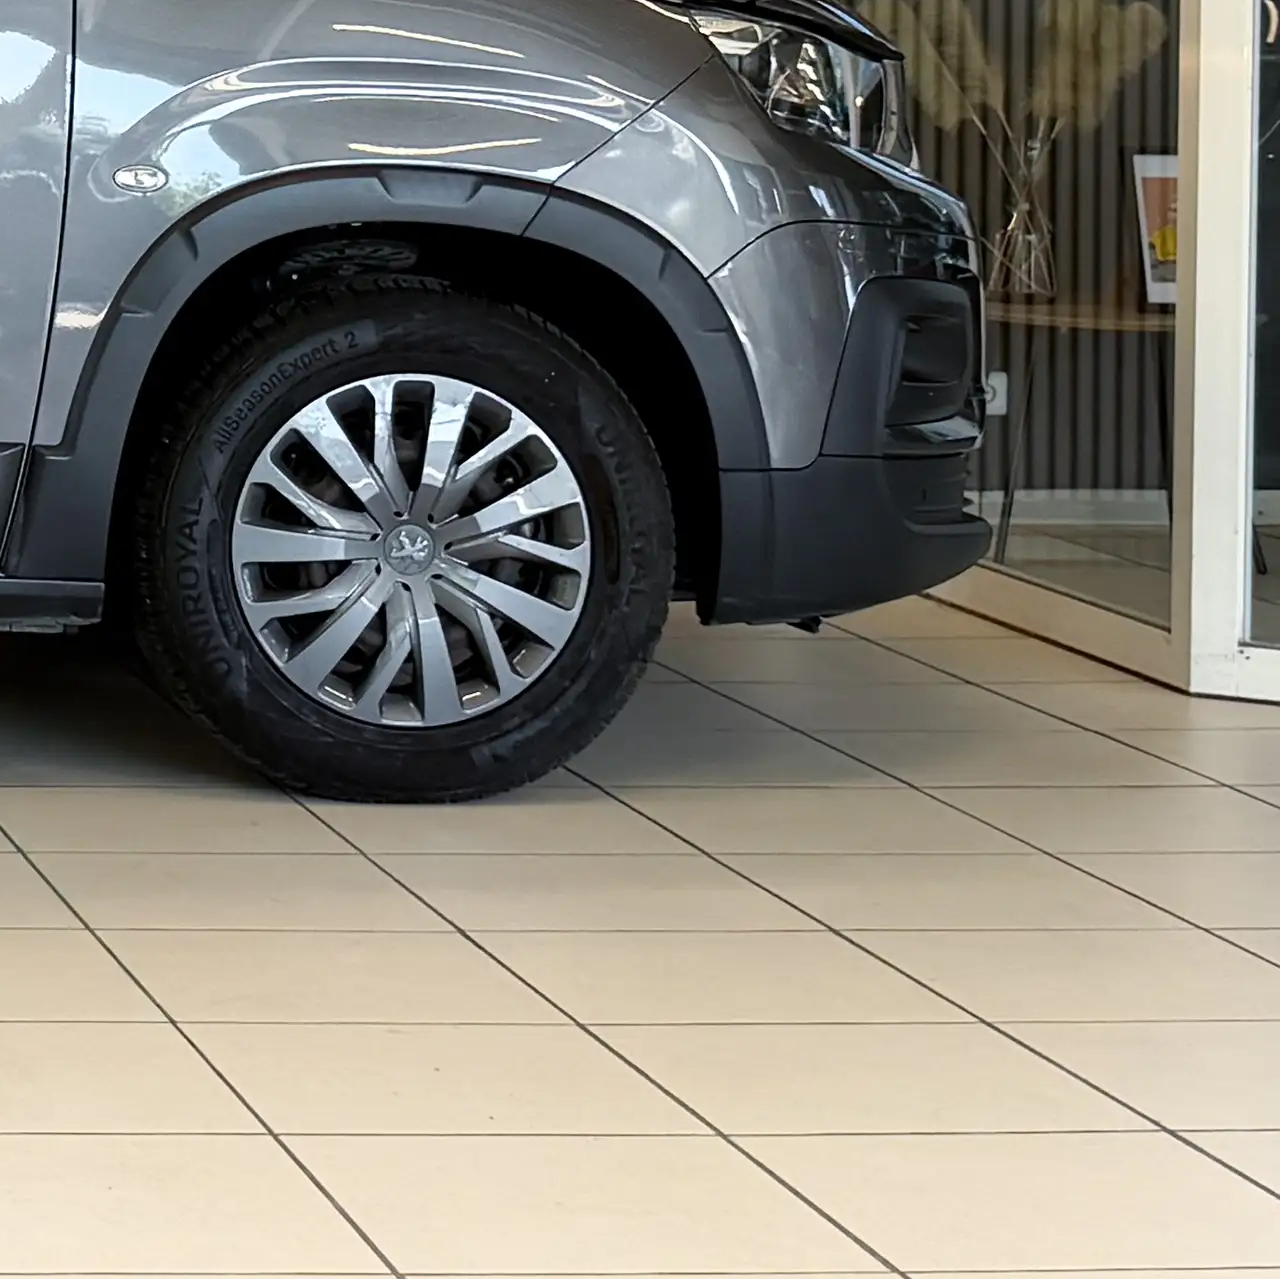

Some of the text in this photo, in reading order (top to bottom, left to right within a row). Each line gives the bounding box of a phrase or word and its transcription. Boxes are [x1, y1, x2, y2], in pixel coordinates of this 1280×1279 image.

[213, 330, 361, 454] AllSeasonExpert 2
[174, 495, 236, 677] UNIROYAL
